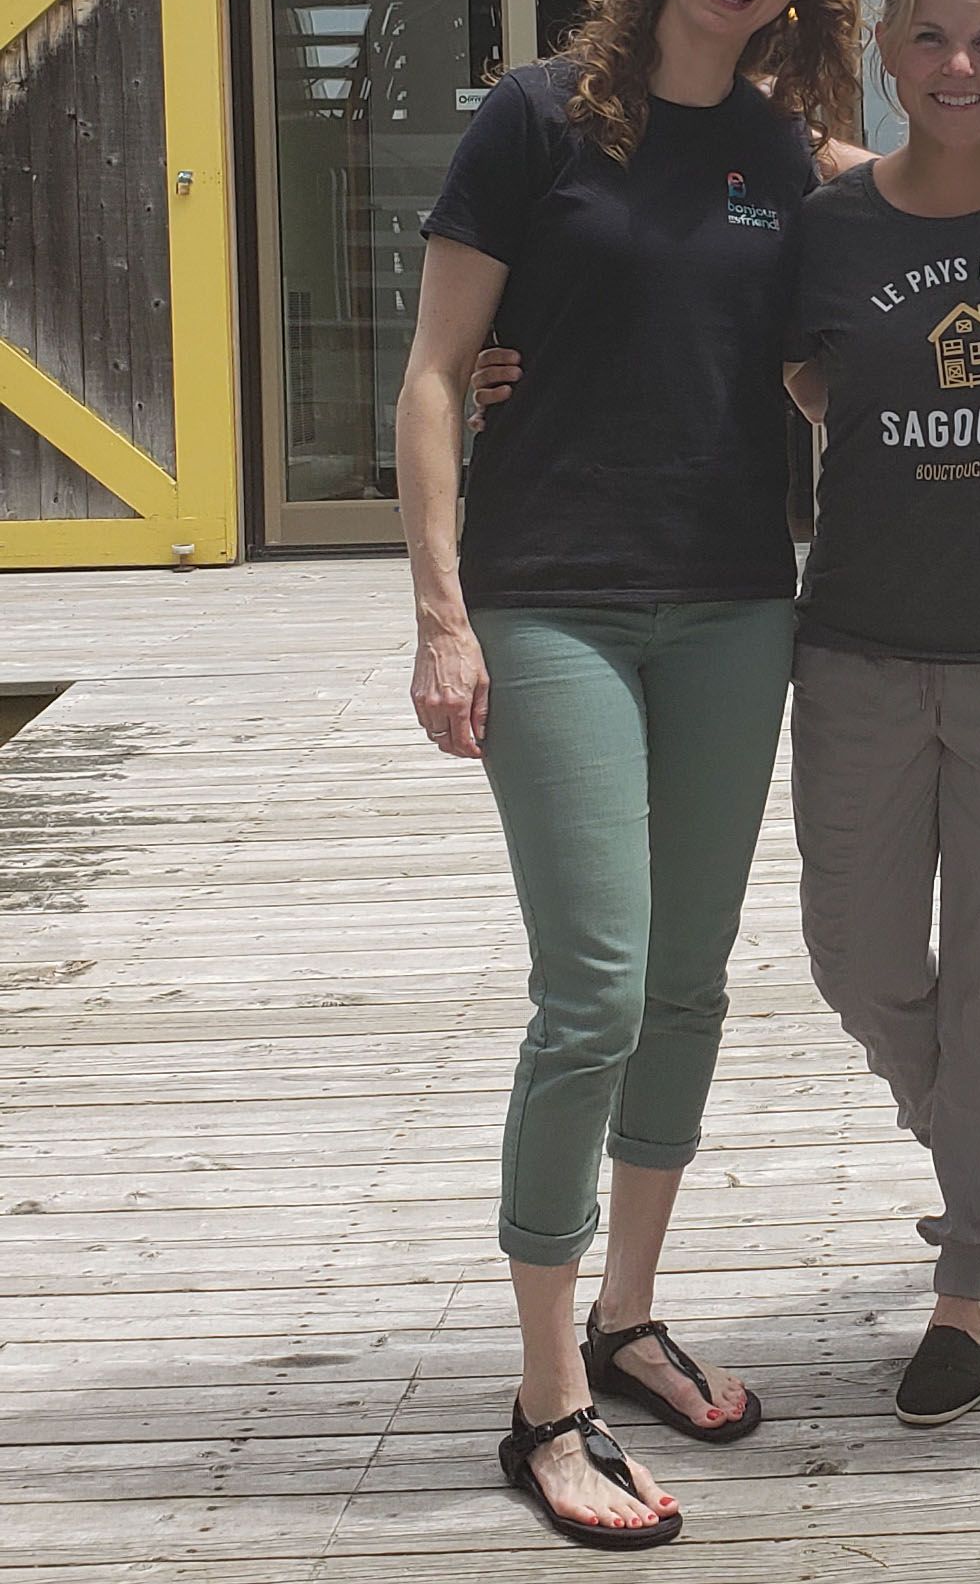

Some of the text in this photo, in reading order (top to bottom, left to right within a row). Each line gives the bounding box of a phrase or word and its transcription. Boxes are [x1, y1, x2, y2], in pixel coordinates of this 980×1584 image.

[727, 197, 777, 218] bonjour
[870, 282, 905, 312] LE
[905, 257, 968, 293] PAYS
